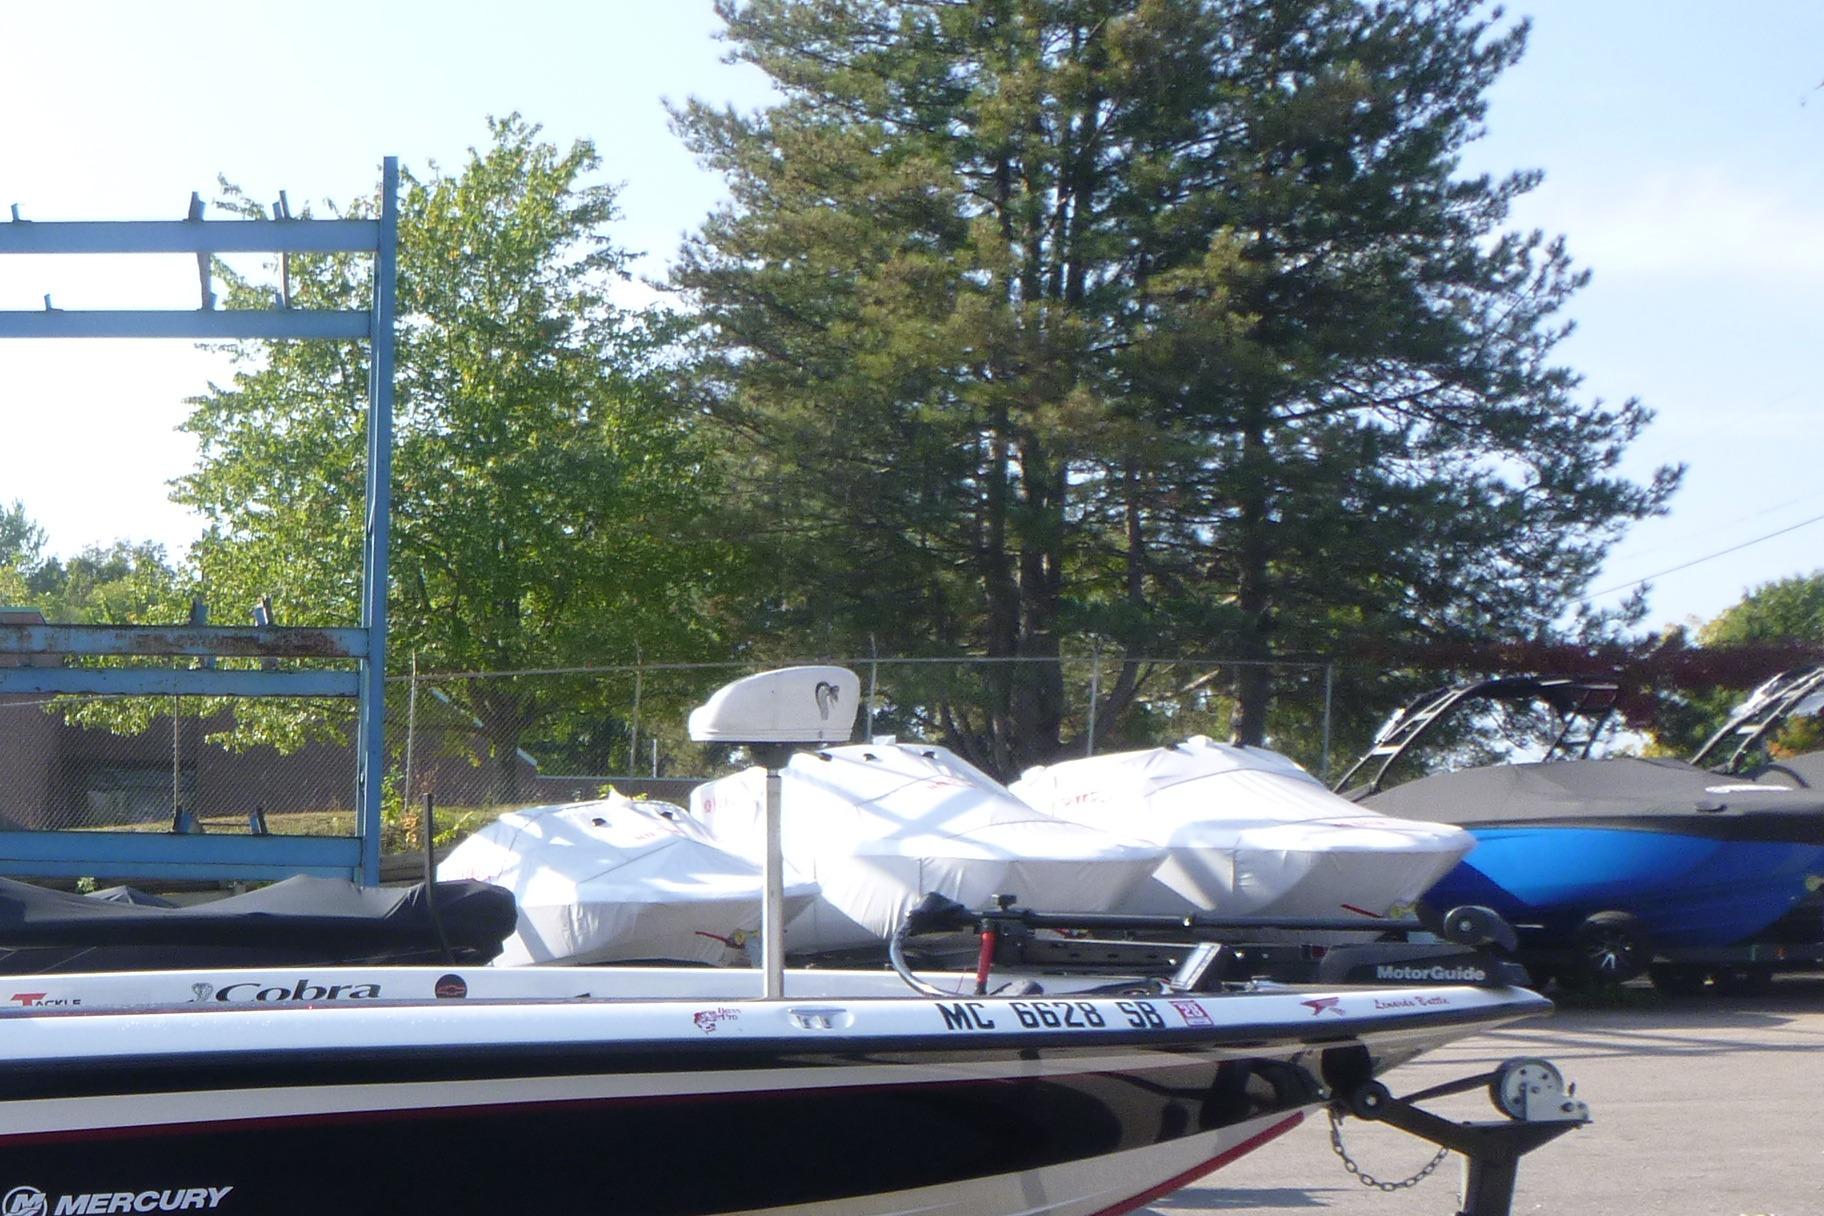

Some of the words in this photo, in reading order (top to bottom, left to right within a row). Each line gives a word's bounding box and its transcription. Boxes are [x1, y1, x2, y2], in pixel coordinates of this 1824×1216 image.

[1377, 965, 1486, 981] MotorGuide
[215, 979, 382, 1001] Cobra
[934, 1003, 996, 1031] MC
[1008, 1002, 1106, 1028] 6628
[1115, 1001, 1166, 1029] SB
[54, 1186, 234, 1216] MERCURY
